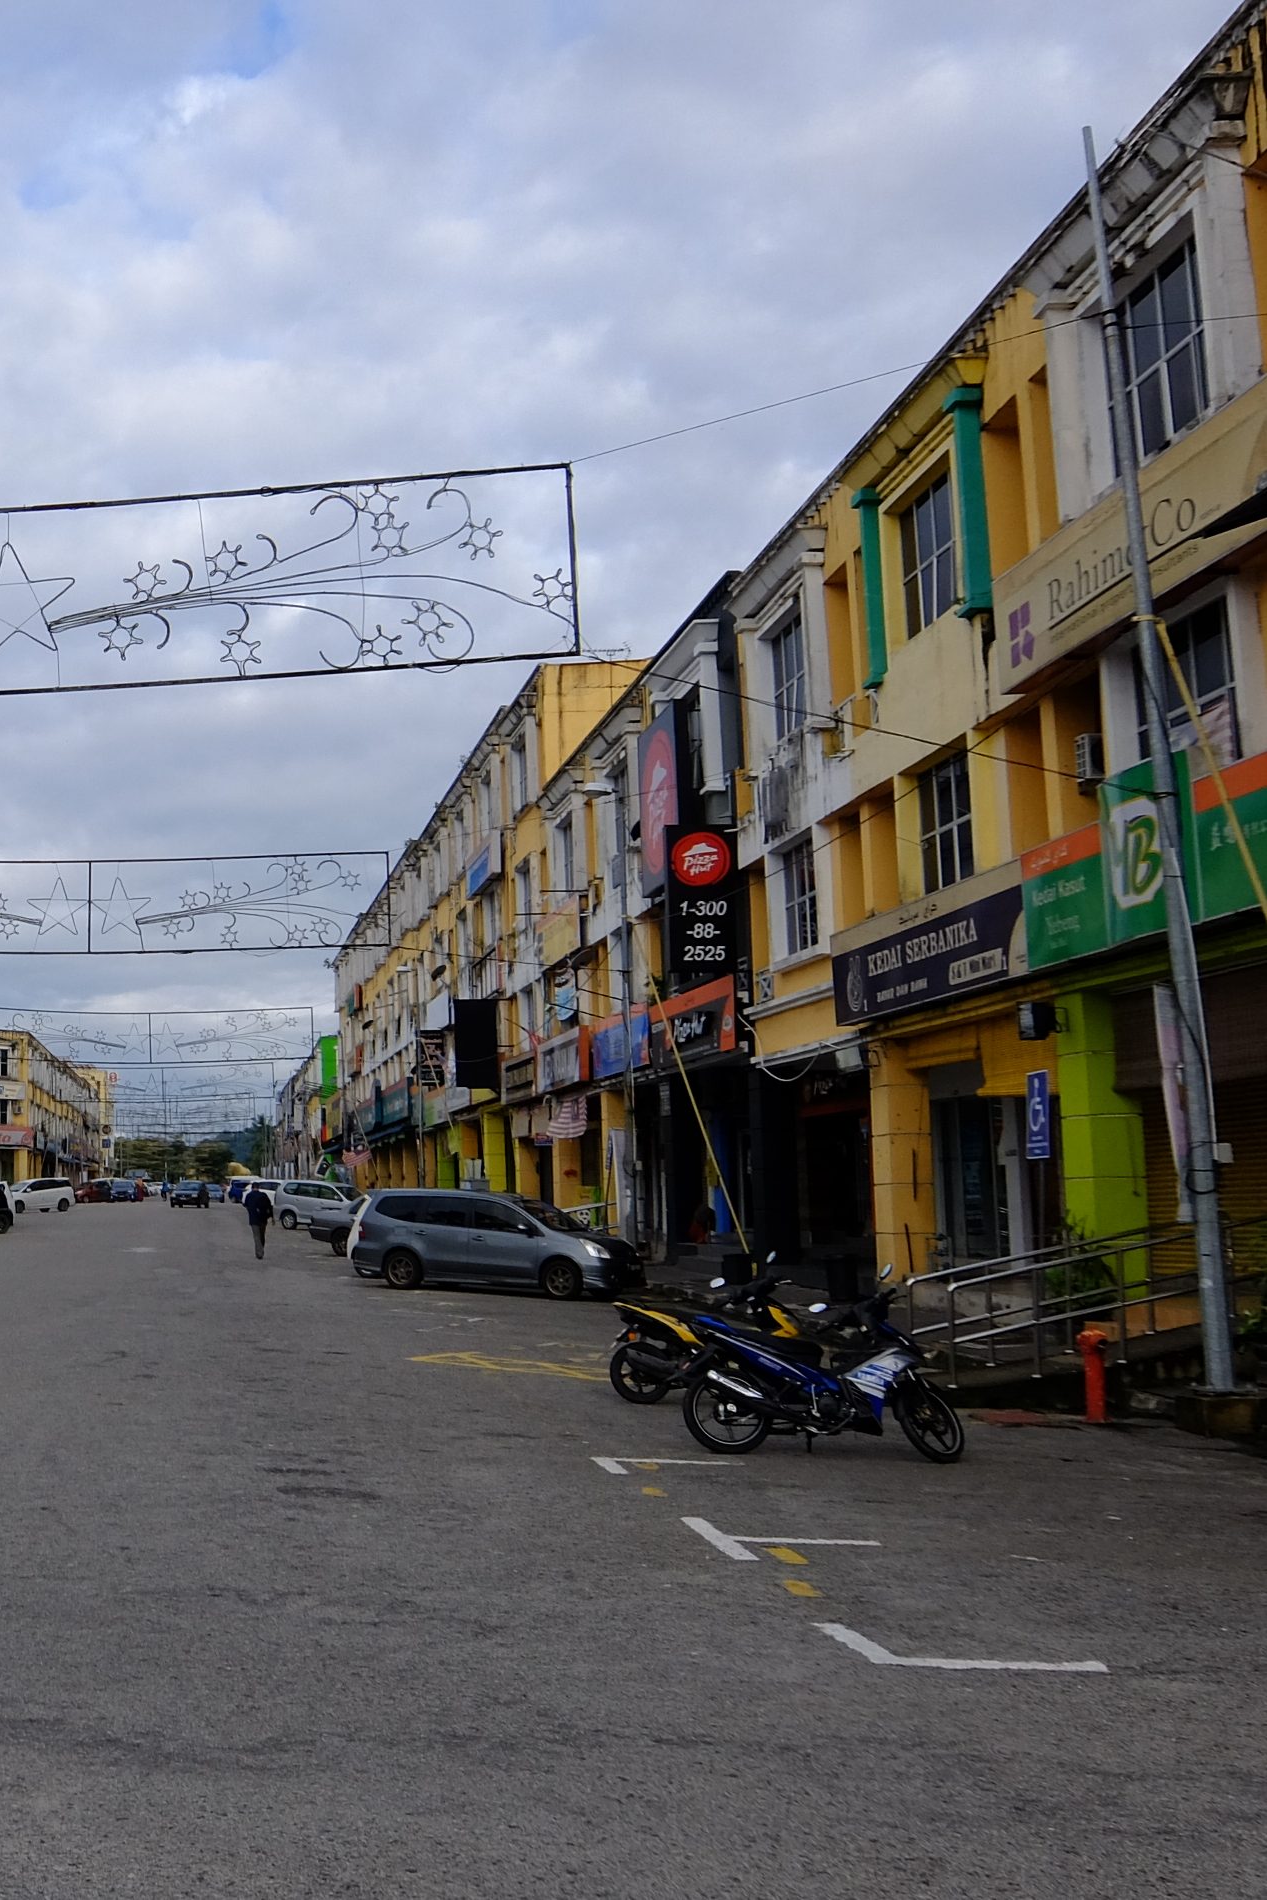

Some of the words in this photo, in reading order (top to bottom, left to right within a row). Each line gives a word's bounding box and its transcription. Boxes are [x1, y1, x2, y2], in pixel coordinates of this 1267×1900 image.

[1047, 547, 1124, 620] Rahim
[1151, 498, 1196, 547] Co
[683, 853, 719, 871] Pizza
[689, 862, 715, 877] Hut
[679, 900, 728, 917] 1-300
[686, 922, 721, 940] -88-
[683, 944, 726, 962] 2525
[867, 944, 903, 977] KEDAI
[905, 917, 978, 964] SERBANIKA
